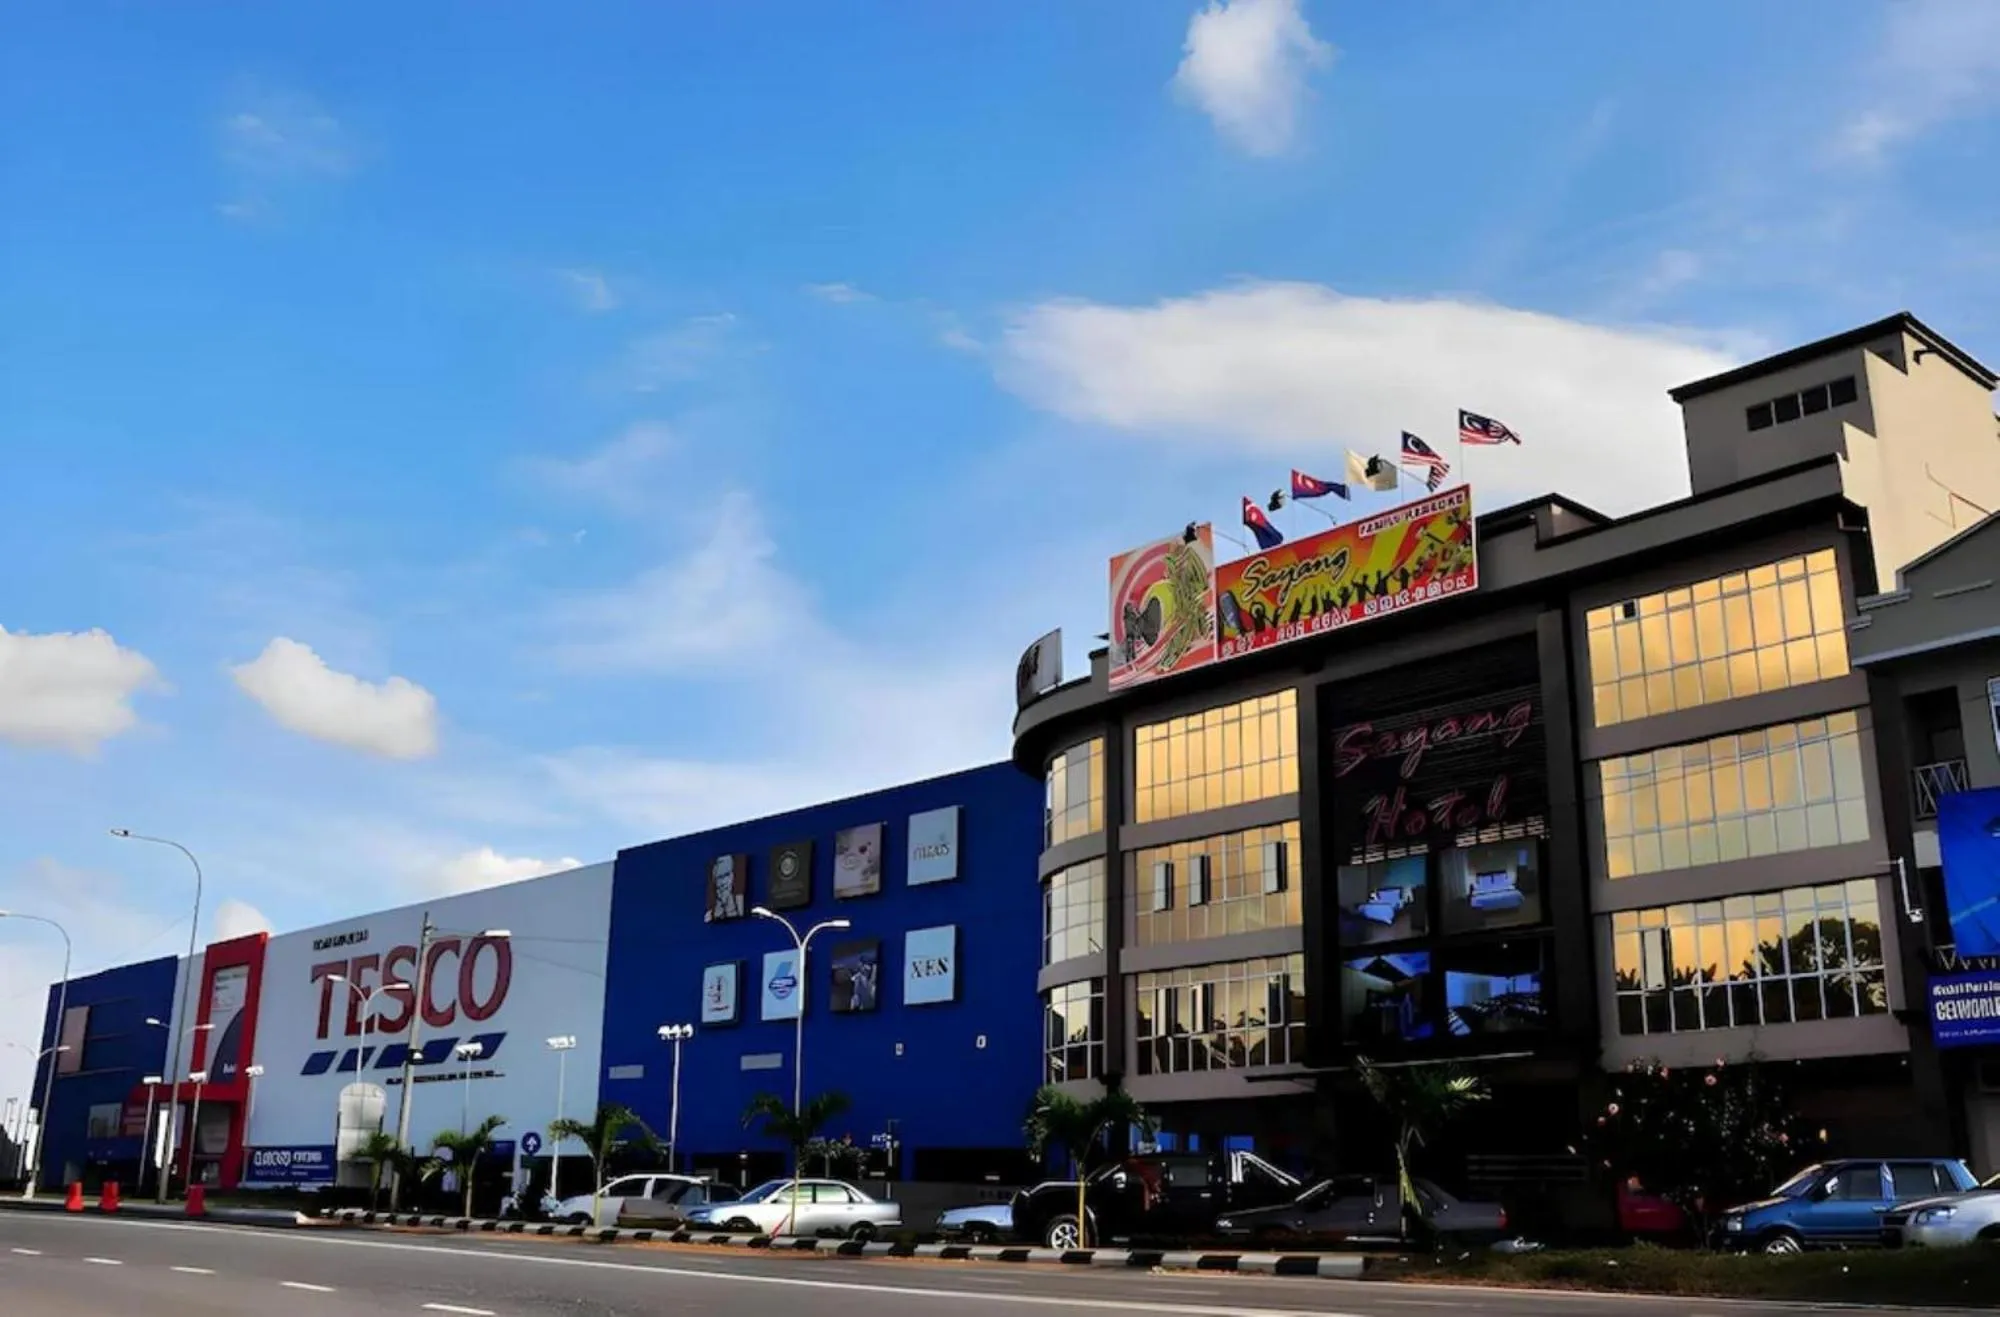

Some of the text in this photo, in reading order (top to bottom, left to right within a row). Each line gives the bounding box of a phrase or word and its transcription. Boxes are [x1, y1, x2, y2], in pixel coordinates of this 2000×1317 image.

[1241, 547, 1351, 607] Sayang
[1336, 700, 1532, 778] Sayang
[1364, 775, 1510, 843] Hotel
[310, 936, 513, 1040] TESCO
